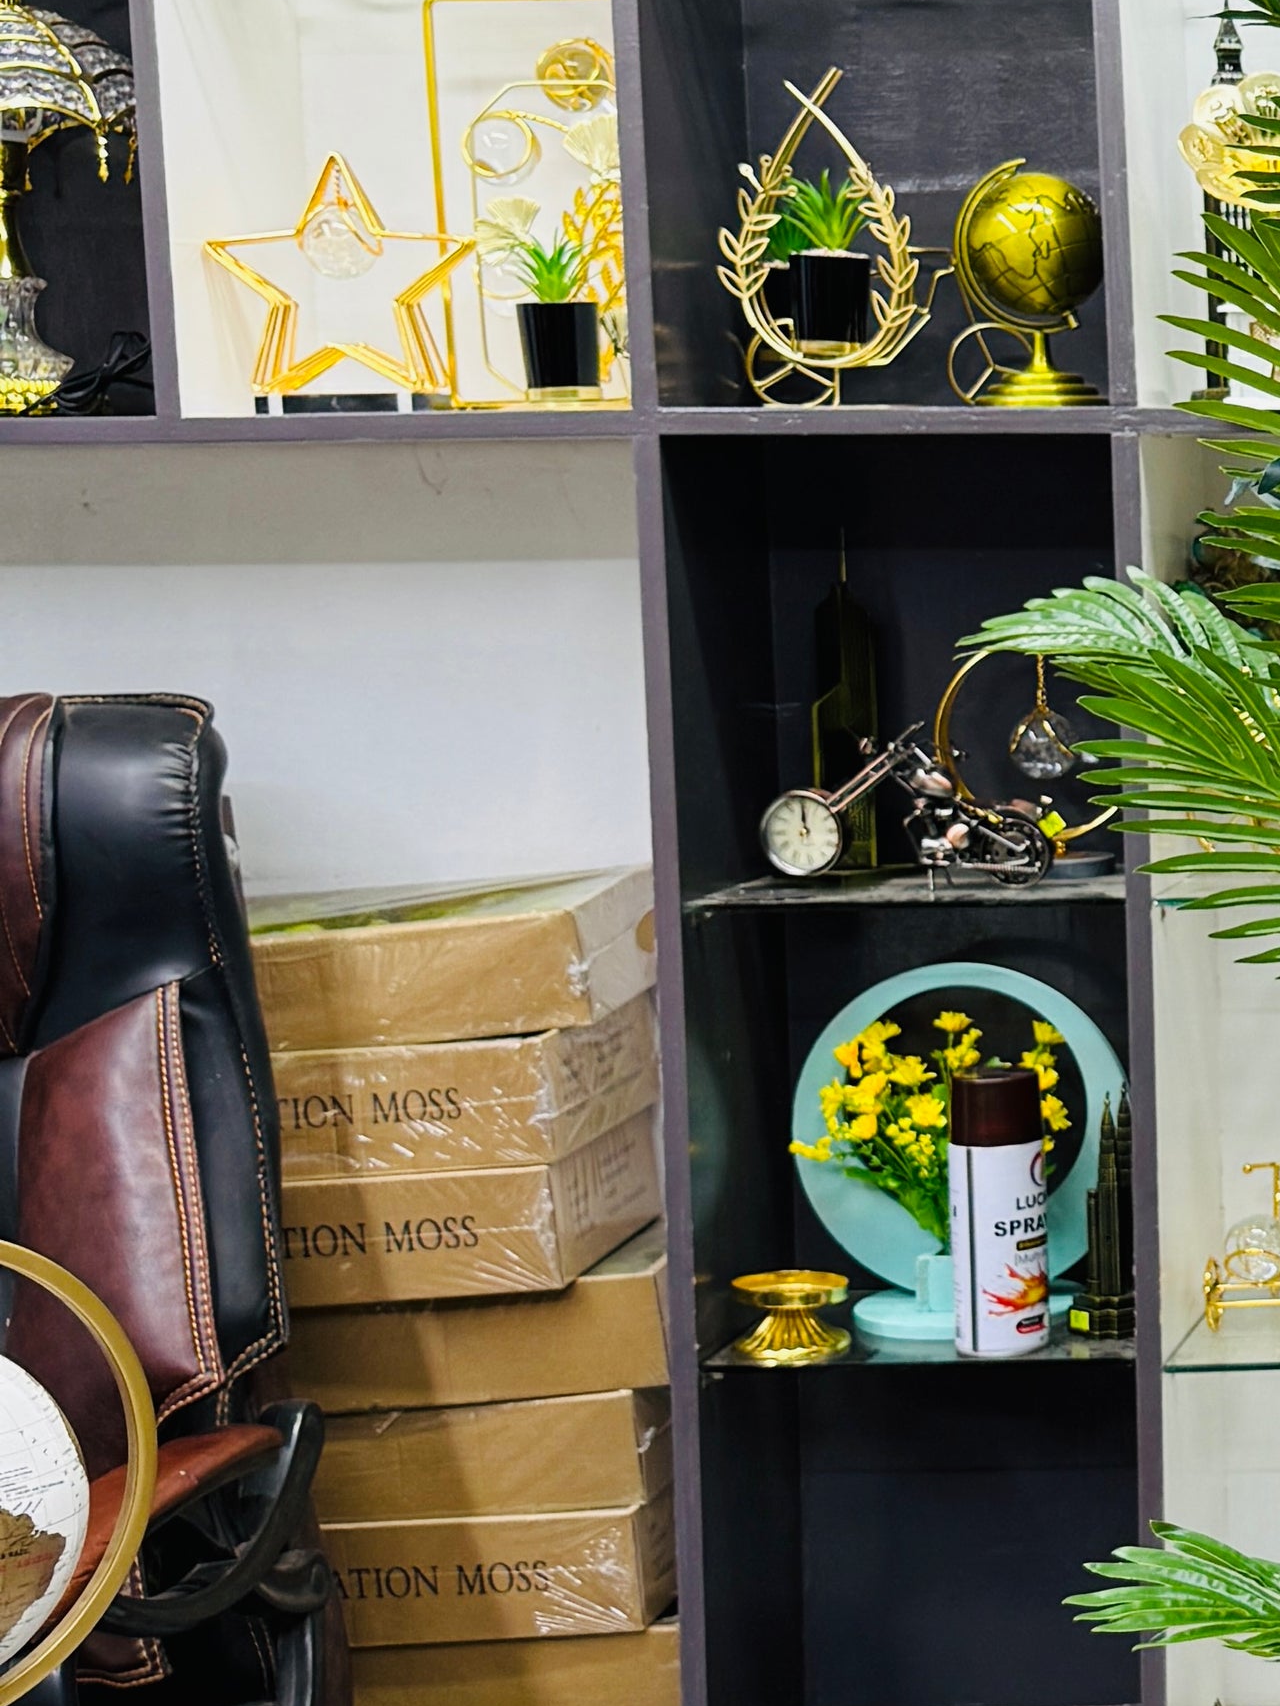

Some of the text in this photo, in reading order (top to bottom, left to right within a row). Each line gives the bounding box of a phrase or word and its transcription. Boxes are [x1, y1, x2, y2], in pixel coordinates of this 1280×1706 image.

[372, 1087, 462, 1125] MOSS
[384, 1214, 480, 1254] MOSS
[456, 1559, 551, 1596] MOSS
